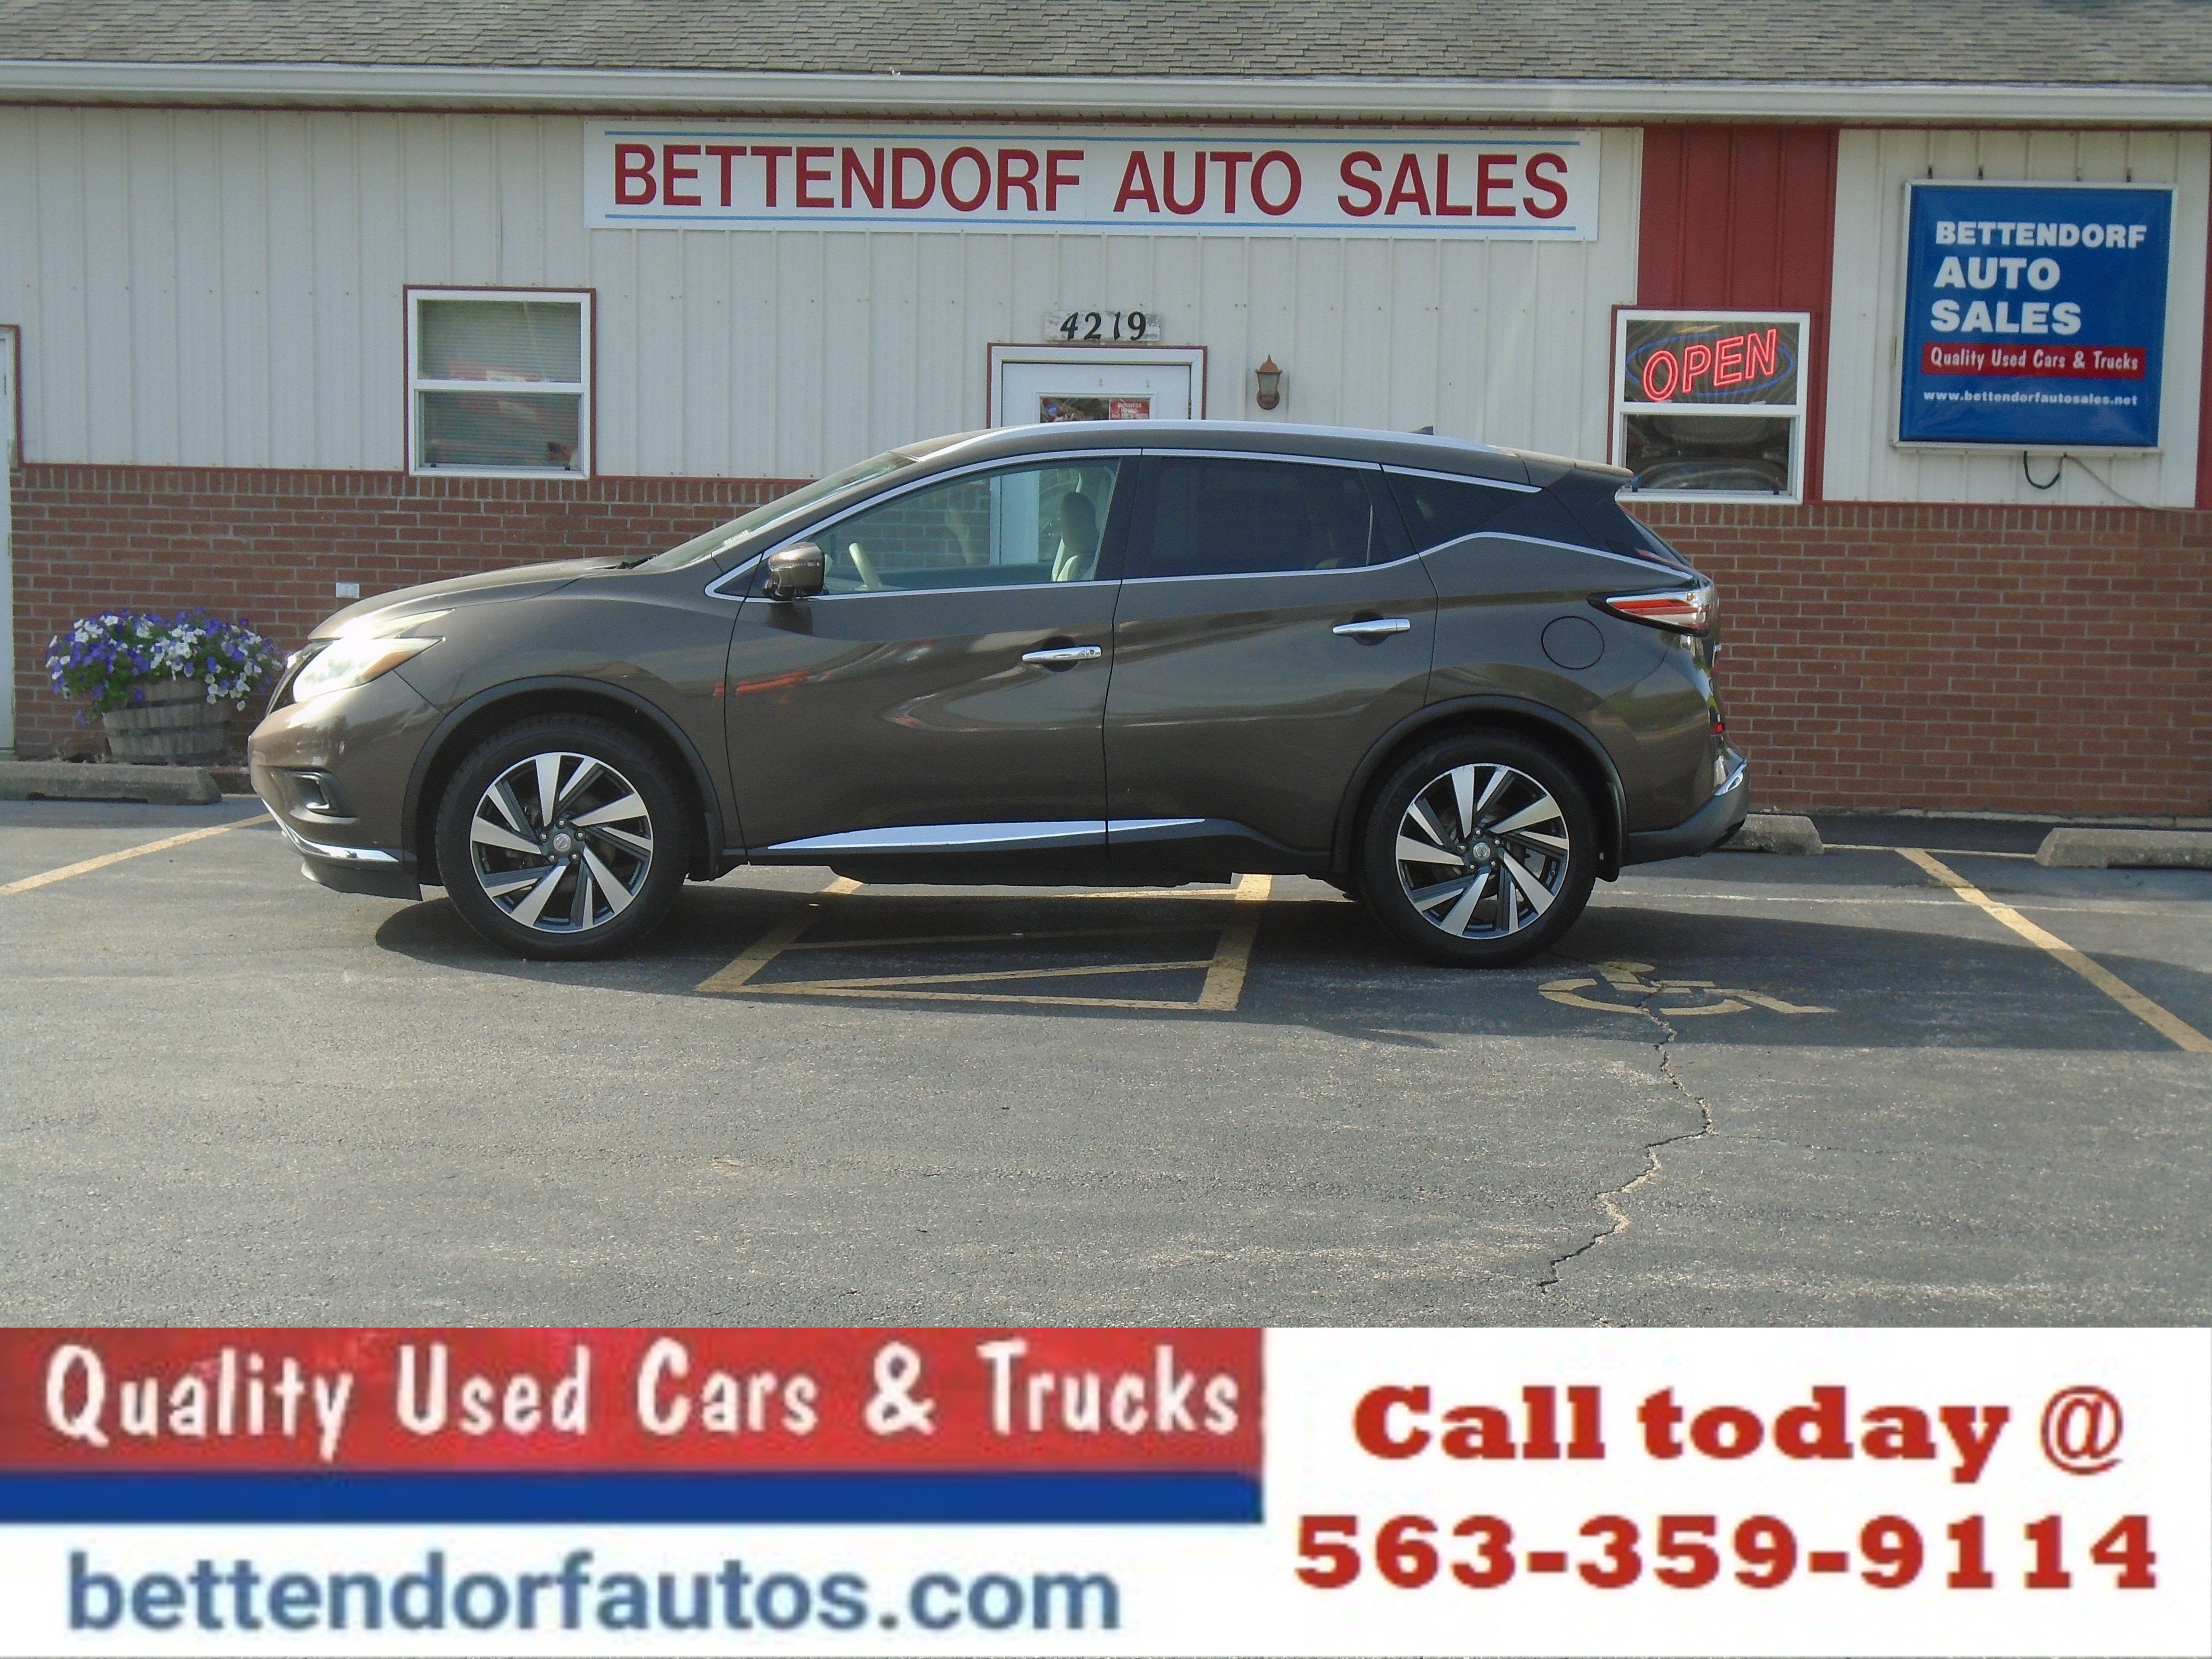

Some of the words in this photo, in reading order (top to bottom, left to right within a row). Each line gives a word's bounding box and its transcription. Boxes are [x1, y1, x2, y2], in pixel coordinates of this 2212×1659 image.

[615, 143, 1085, 212] BETTENDORF
[1113, 150, 1302, 216] AUTO
[1338, 152, 1568, 219] SALES
[1936, 221, 2147, 249] BETTENDORF
[1934, 256, 2060, 291] AUTO
[1060, 311, 1146, 340] 4219
[1931, 299, 2081, 335] SALES
[1643, 328, 1777, 402] OPEN
[1931, 346, 1985, 371] Quality
[1991, 348, 2027, 368] Used
[2033, 349, 2066, 368] Cars
[2072, 350, 2085, 369] &
[2093, 350, 2139, 371] Trucks
[1924, 390, 2138, 405] www.bettendorfautosales.net
